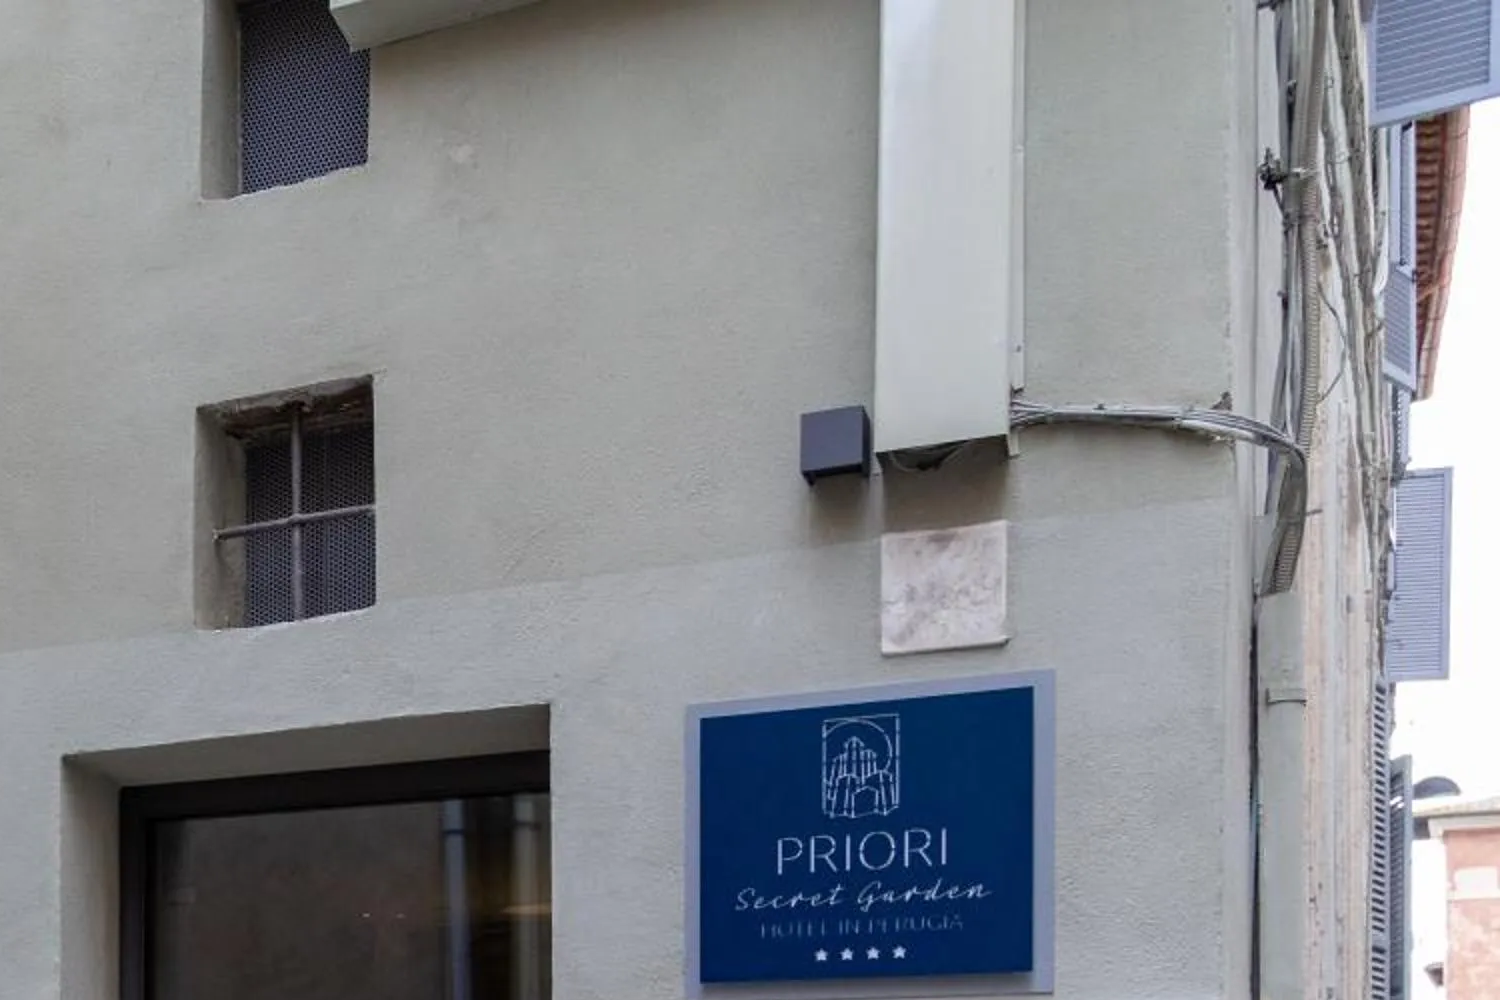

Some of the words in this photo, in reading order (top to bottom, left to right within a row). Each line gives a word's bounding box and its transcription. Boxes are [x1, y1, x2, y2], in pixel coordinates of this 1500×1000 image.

[776, 827, 948, 876] PRIORI
[735, 883, 846, 911] Secret
[857, 877, 992, 912] Garden
